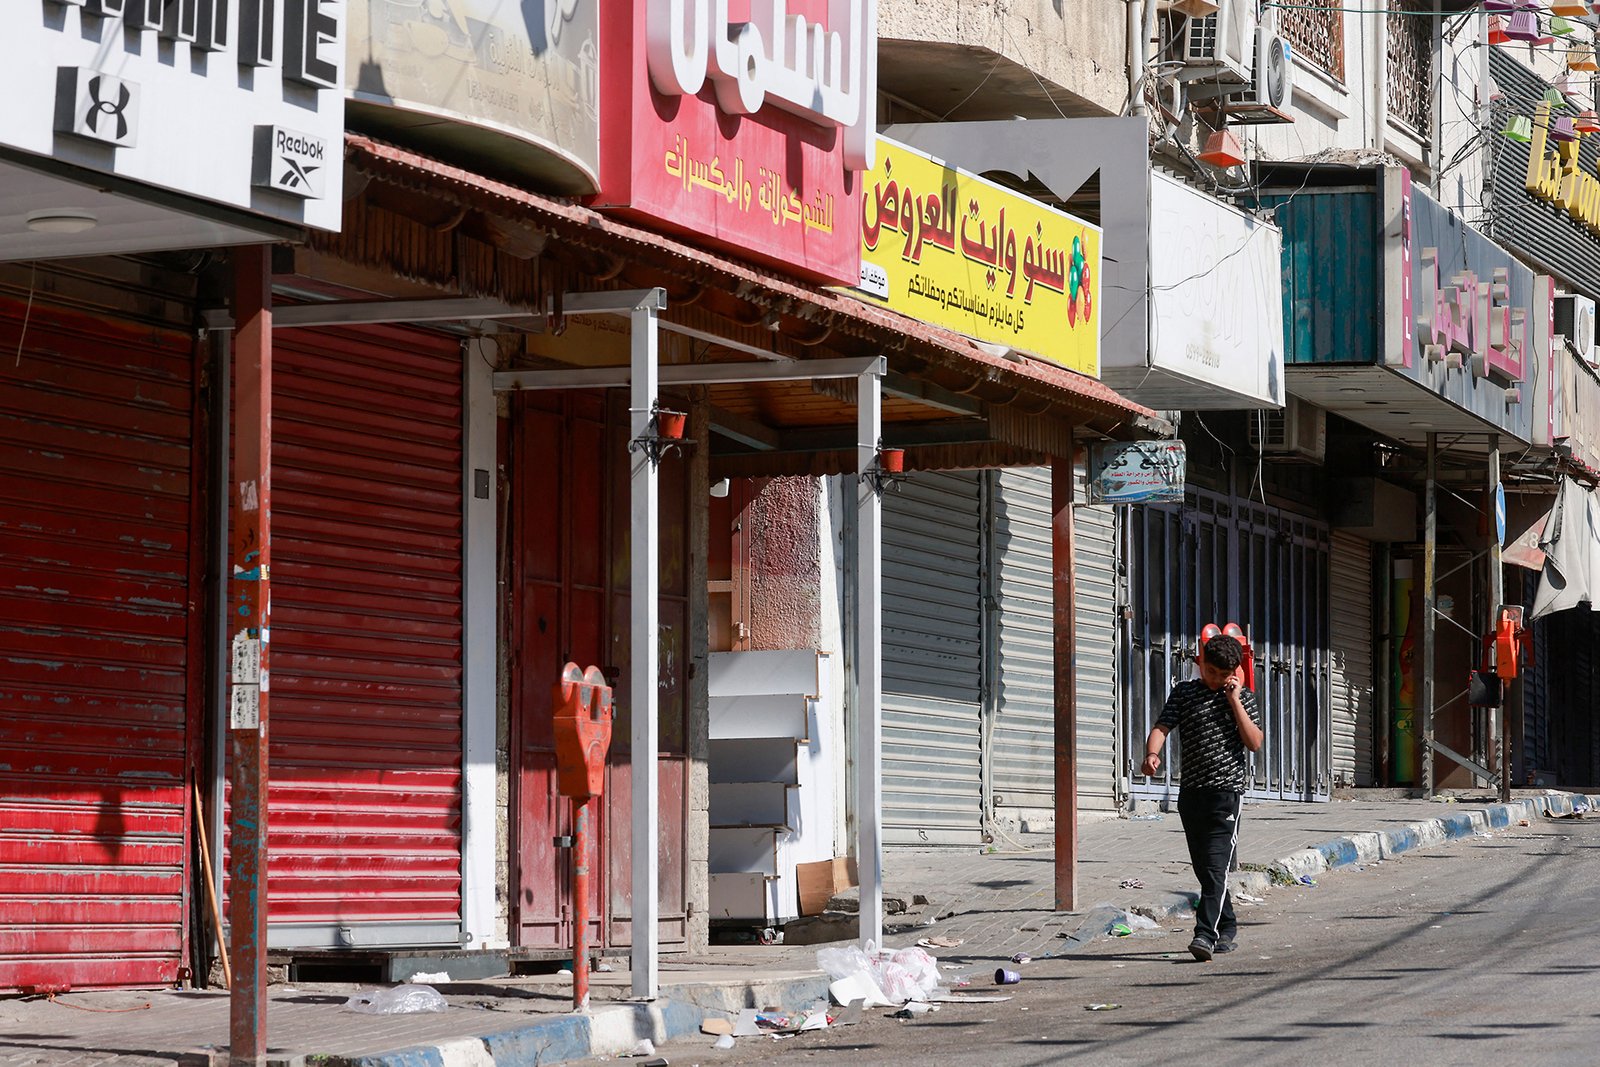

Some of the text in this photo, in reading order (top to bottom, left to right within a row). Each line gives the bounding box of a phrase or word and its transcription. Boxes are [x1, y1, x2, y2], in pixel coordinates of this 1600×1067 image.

[276, 130, 324, 160] Reebok
[665, 134, 752, 212] والمكسرات
[862, 156, 1066, 306] سنو وايت للعروض
[907, 273, 1024, 335] كل ما يلزم لمناسباتكم وحفلاتكم
